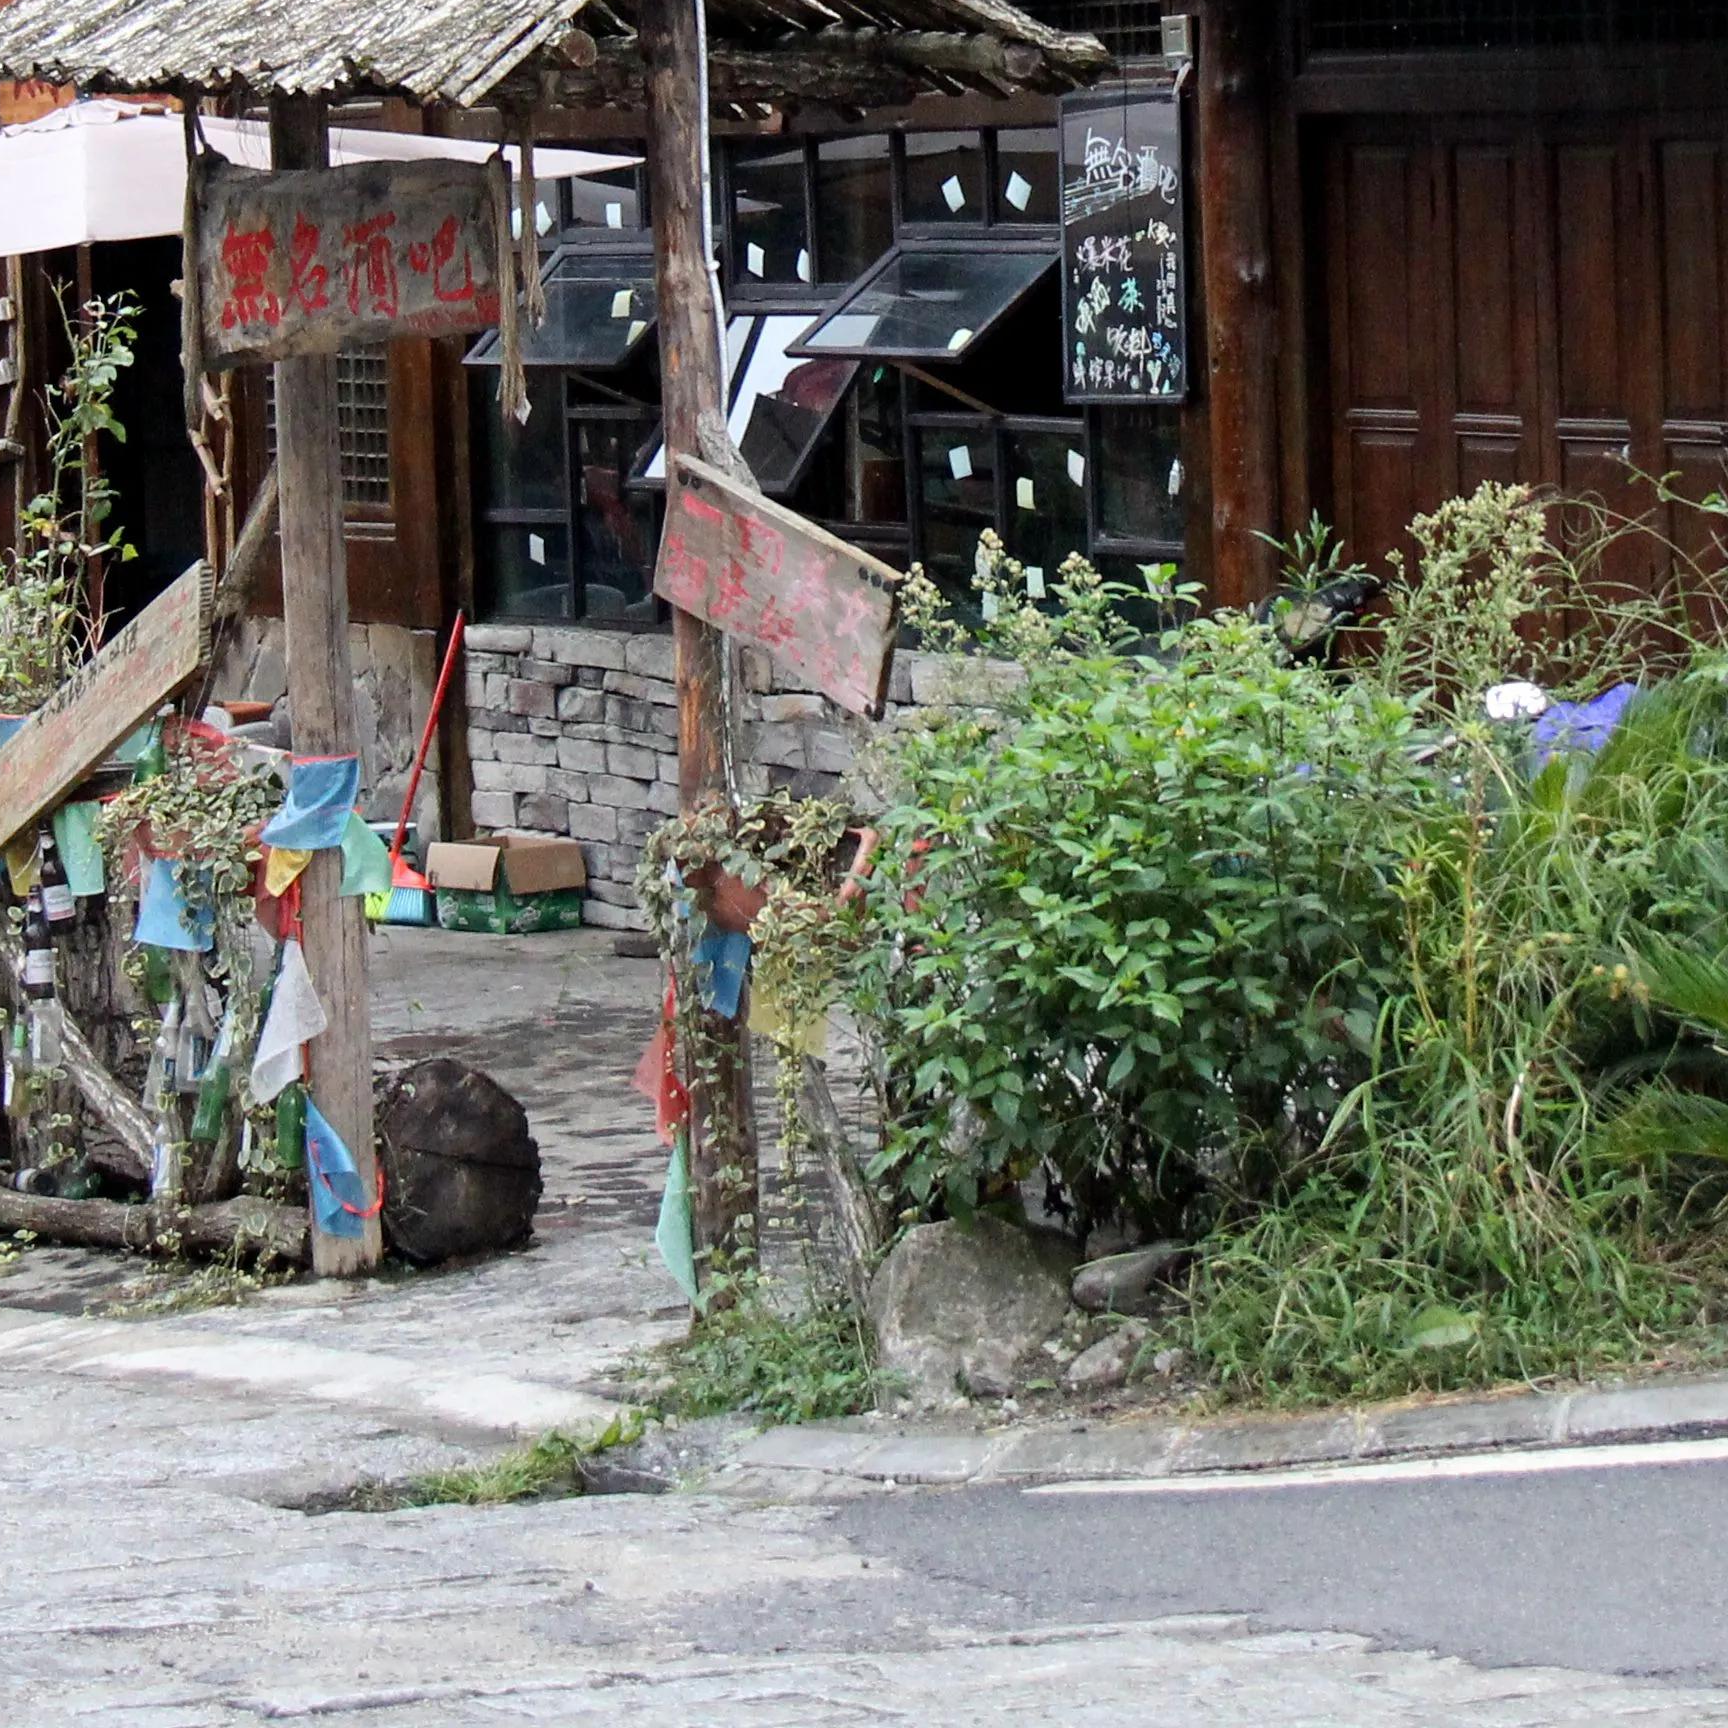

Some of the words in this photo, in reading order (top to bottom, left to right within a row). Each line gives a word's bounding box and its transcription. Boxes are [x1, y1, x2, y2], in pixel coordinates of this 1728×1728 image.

[220, 210, 475, 331] 無名酒吧
[1118, 277, 1145, 313] 茶
